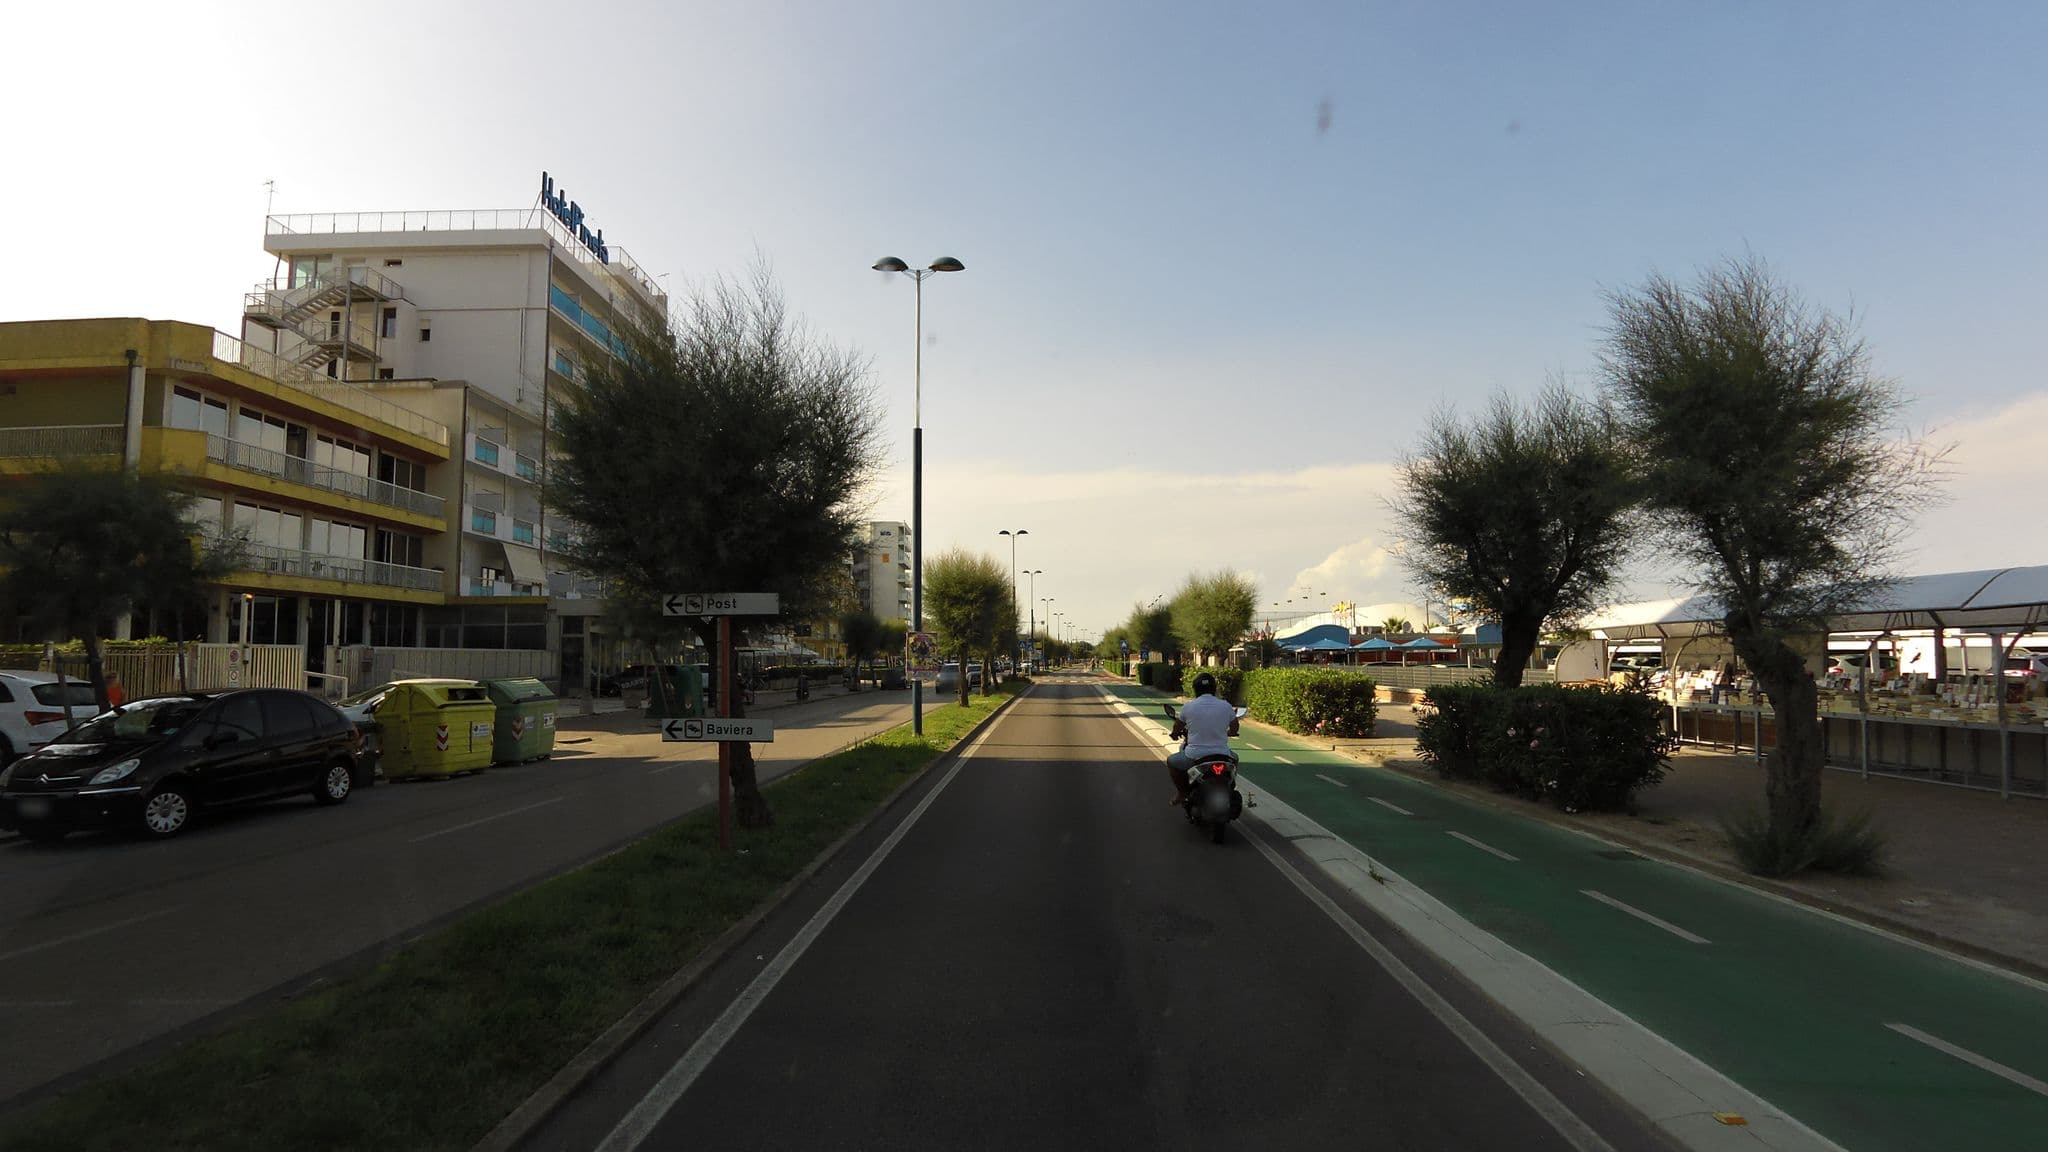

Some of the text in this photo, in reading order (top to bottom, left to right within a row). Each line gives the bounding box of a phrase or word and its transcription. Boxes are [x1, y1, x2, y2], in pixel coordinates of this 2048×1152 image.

[542, 171, 576, 233] Hotel
[706, 598, 737, 609] Post
[706, 724, 753, 735] Baviera
